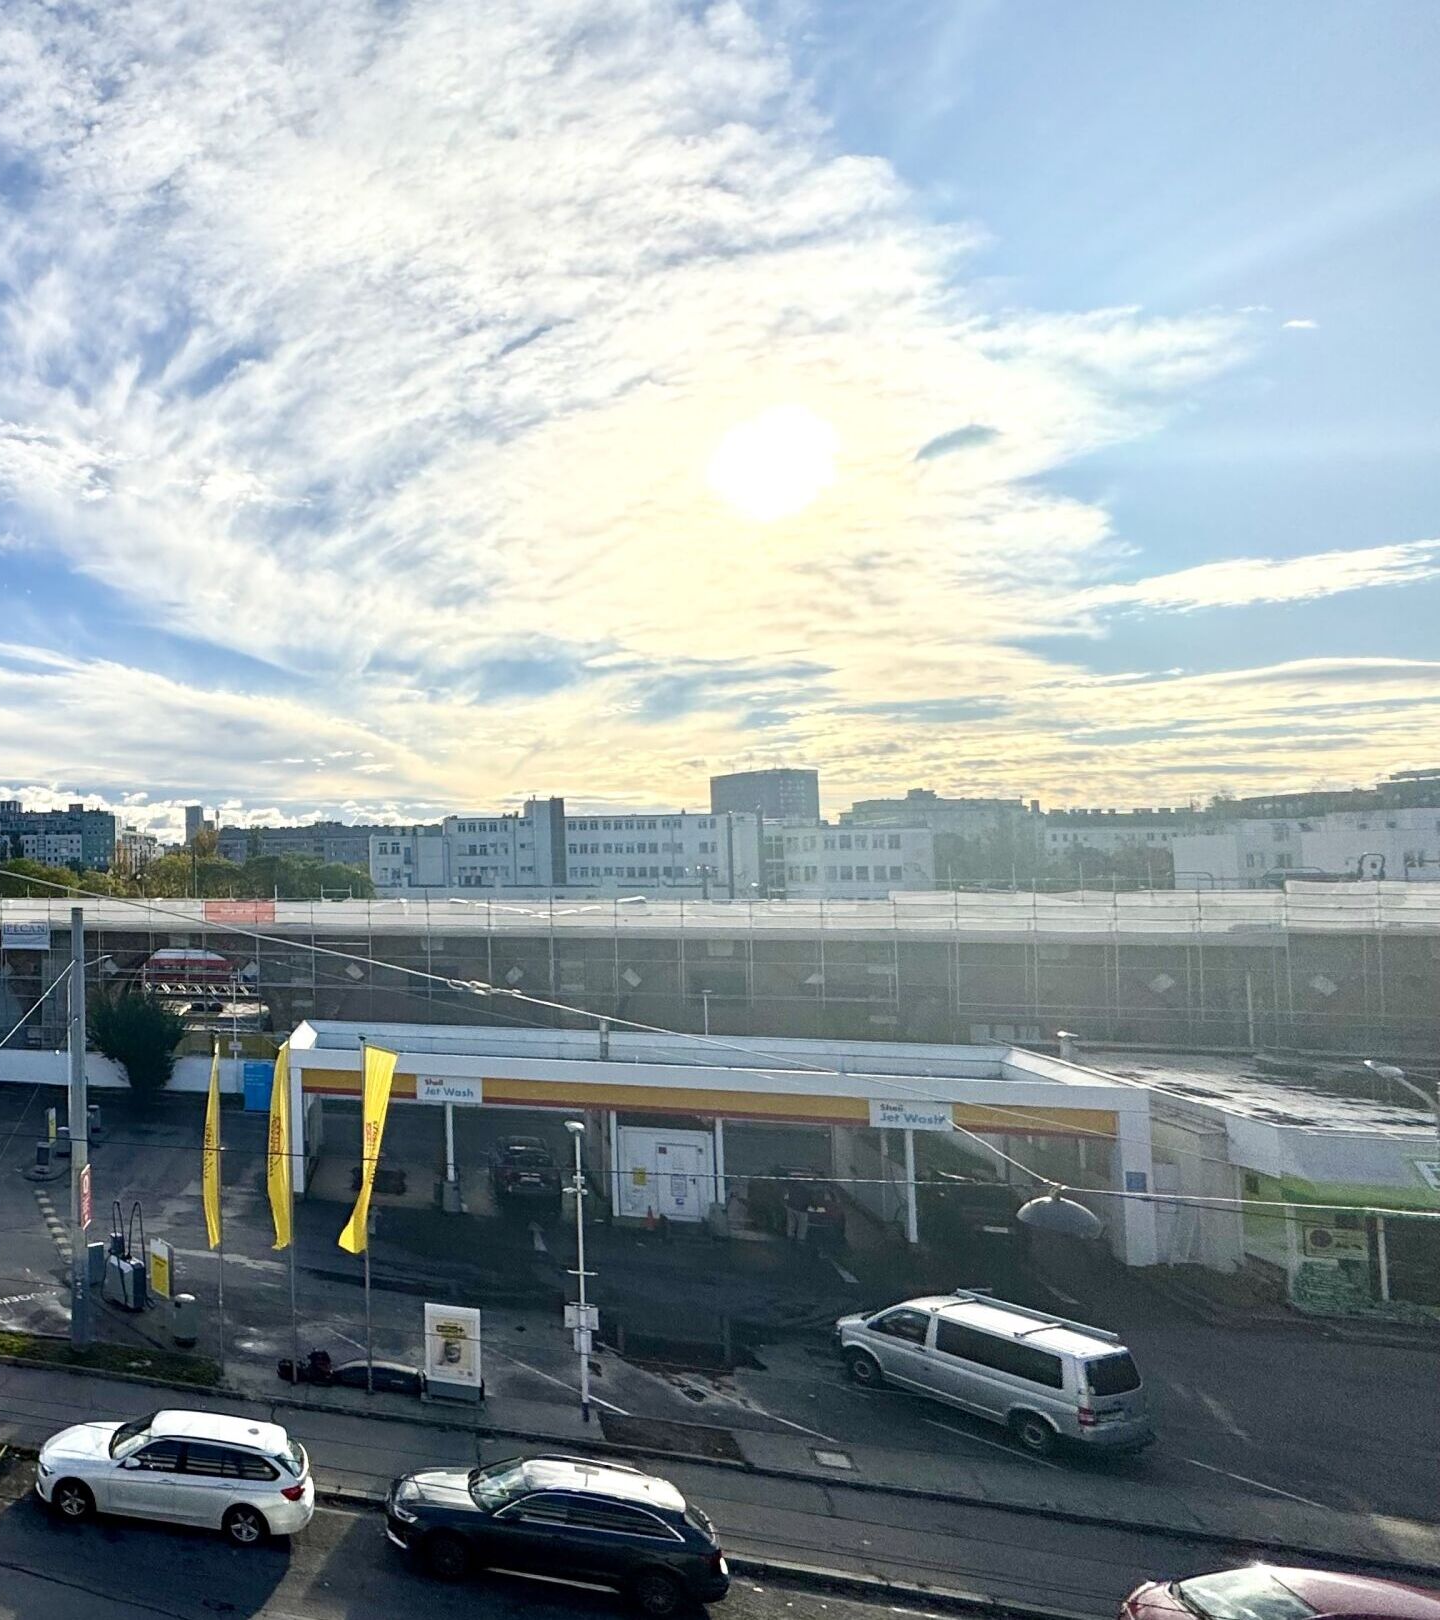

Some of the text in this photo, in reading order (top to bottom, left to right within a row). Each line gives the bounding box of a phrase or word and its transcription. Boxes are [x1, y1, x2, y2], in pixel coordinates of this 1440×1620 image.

[425, 1087, 474, 1097] Jet Wash
[880, 1112, 945, 1125] Jet Wash
